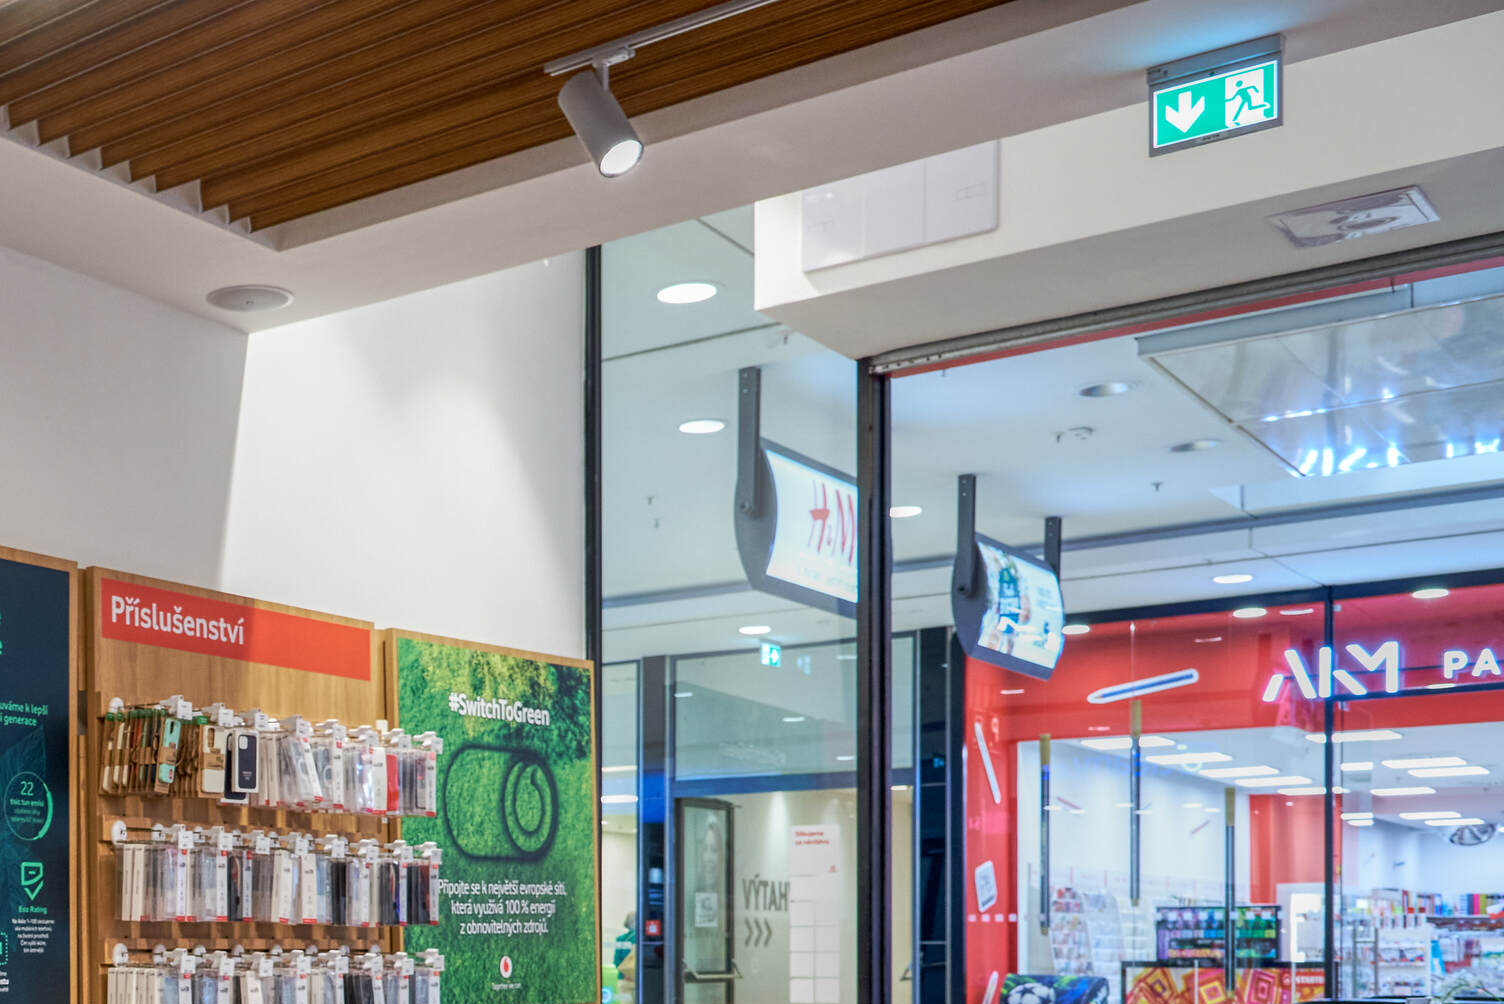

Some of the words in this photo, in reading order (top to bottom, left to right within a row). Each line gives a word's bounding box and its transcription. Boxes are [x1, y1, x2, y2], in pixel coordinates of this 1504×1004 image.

[111, 595, 245, 645] Příslušenství
[31, 704, 48, 716] lepší
[448, 692, 550, 726] #SwitchToGreen
[4, 715, 37, 726] generace
[20, 781, 34, 796] 22
[438, 879, 470, 897] Připojte
[471, 883, 481, 894] se
[482, 880, 487, 894] k
[488, 880, 519, 897] největší
[519, 881, 553, 897] evropské
[451, 899, 472, 914] která
[473, 899, 504, 918] využívá
[460, 922, 465, 934] z
[466, 919, 522, 937] obnovitelných
